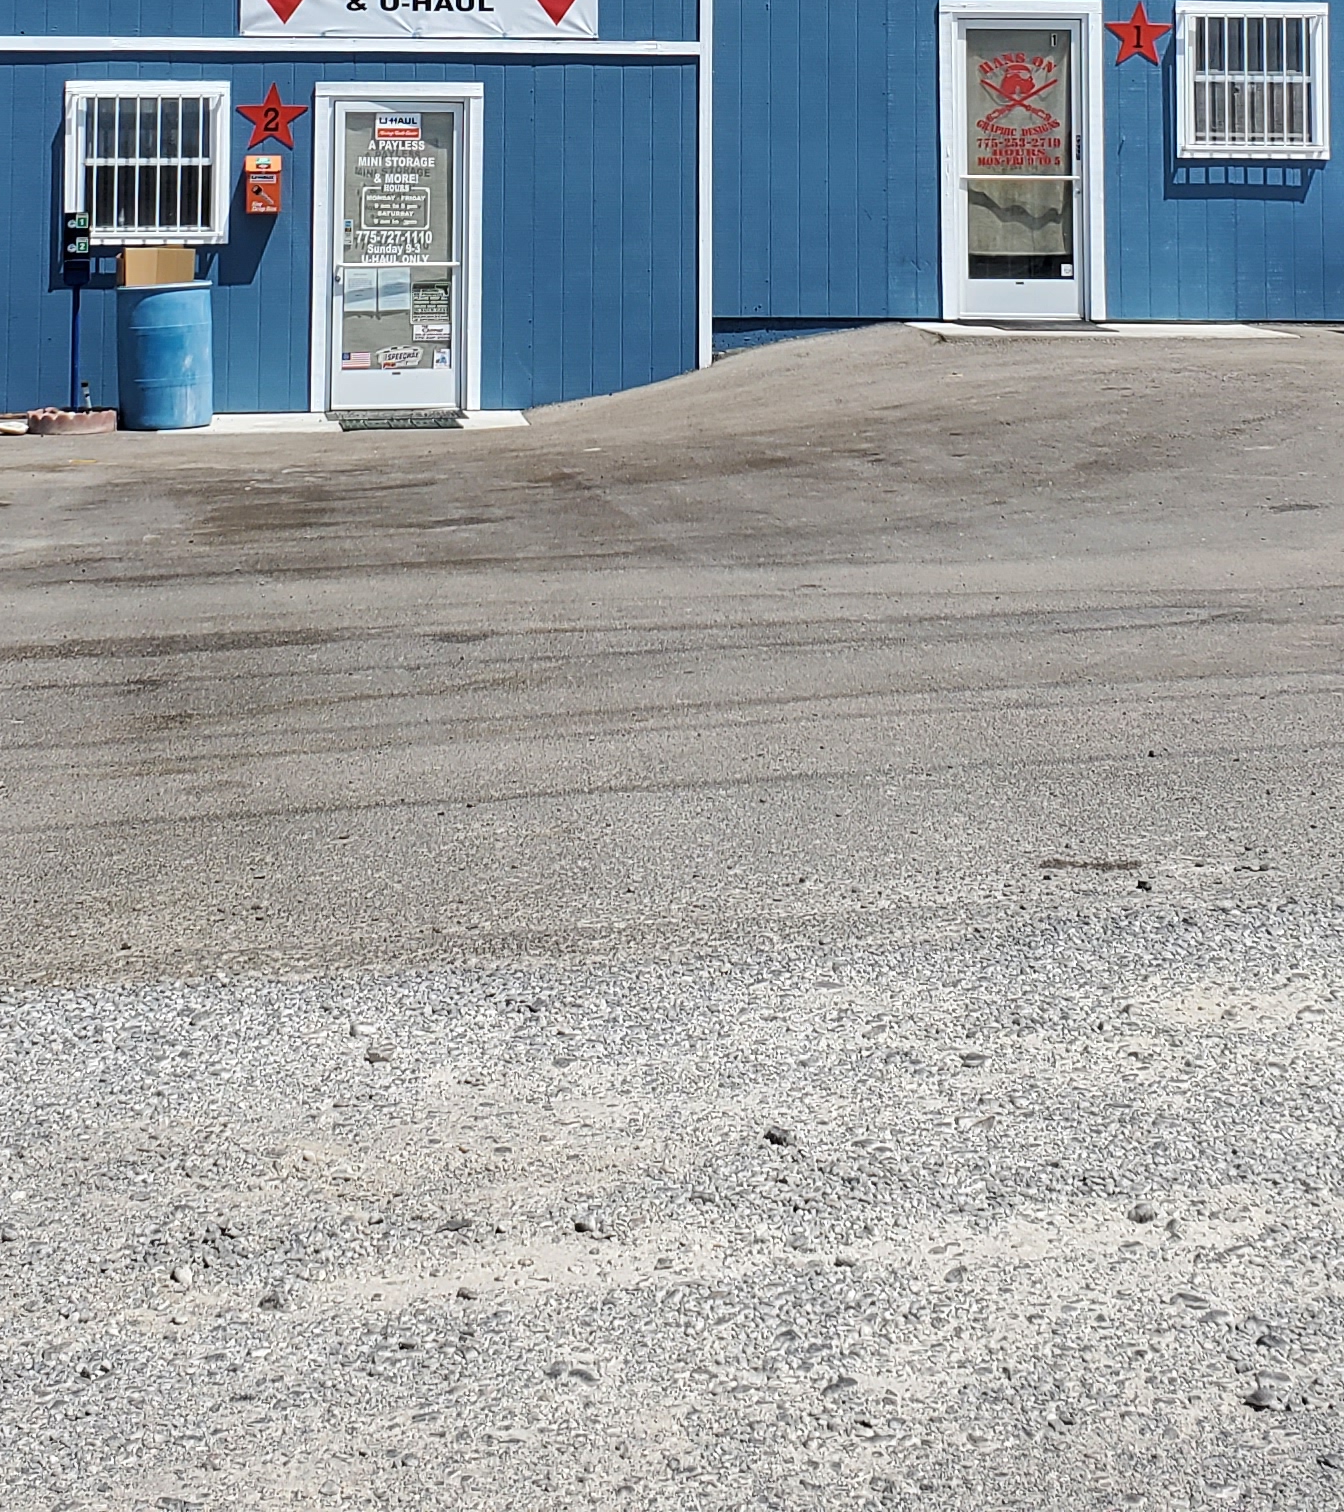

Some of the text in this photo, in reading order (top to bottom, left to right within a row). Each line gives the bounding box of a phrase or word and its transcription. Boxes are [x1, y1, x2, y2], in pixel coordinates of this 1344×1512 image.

[1133, 25, 1143, 48] 1
[264, 107, 279, 132] 2
[379, 117, 418, 125] U-HAUL
[368, 140, 425, 151] A PAYLESS
[358, 157, 435, 167] MINI STORAGE
[1039, 157, 1052, 165] TO
[1054, 157, 1061, 165] 5
[374, 173, 419, 184] & MORE!
[356, 231, 433, 244] 775-727-1110
[367, 244, 420, 255] Sunday 9-3
[361, 255, 429, 263] U-HAUL ONLY
